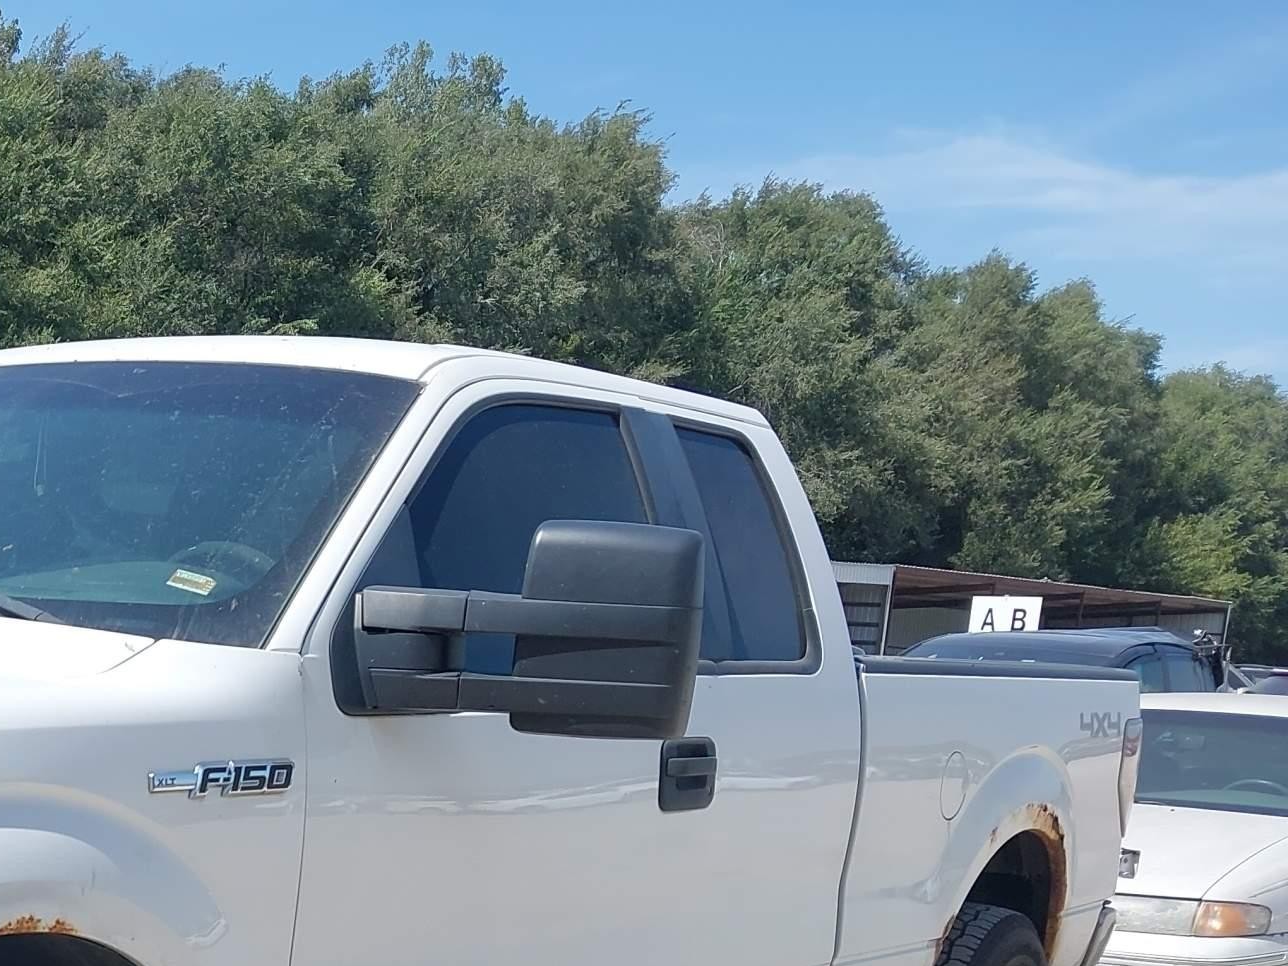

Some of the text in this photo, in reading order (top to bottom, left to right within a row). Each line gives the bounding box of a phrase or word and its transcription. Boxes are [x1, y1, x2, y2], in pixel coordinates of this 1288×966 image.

[981, 607, 1028, 632] A B
[1079, 711, 1122, 738] 4X4
[156, 776, 177, 787] XLT
